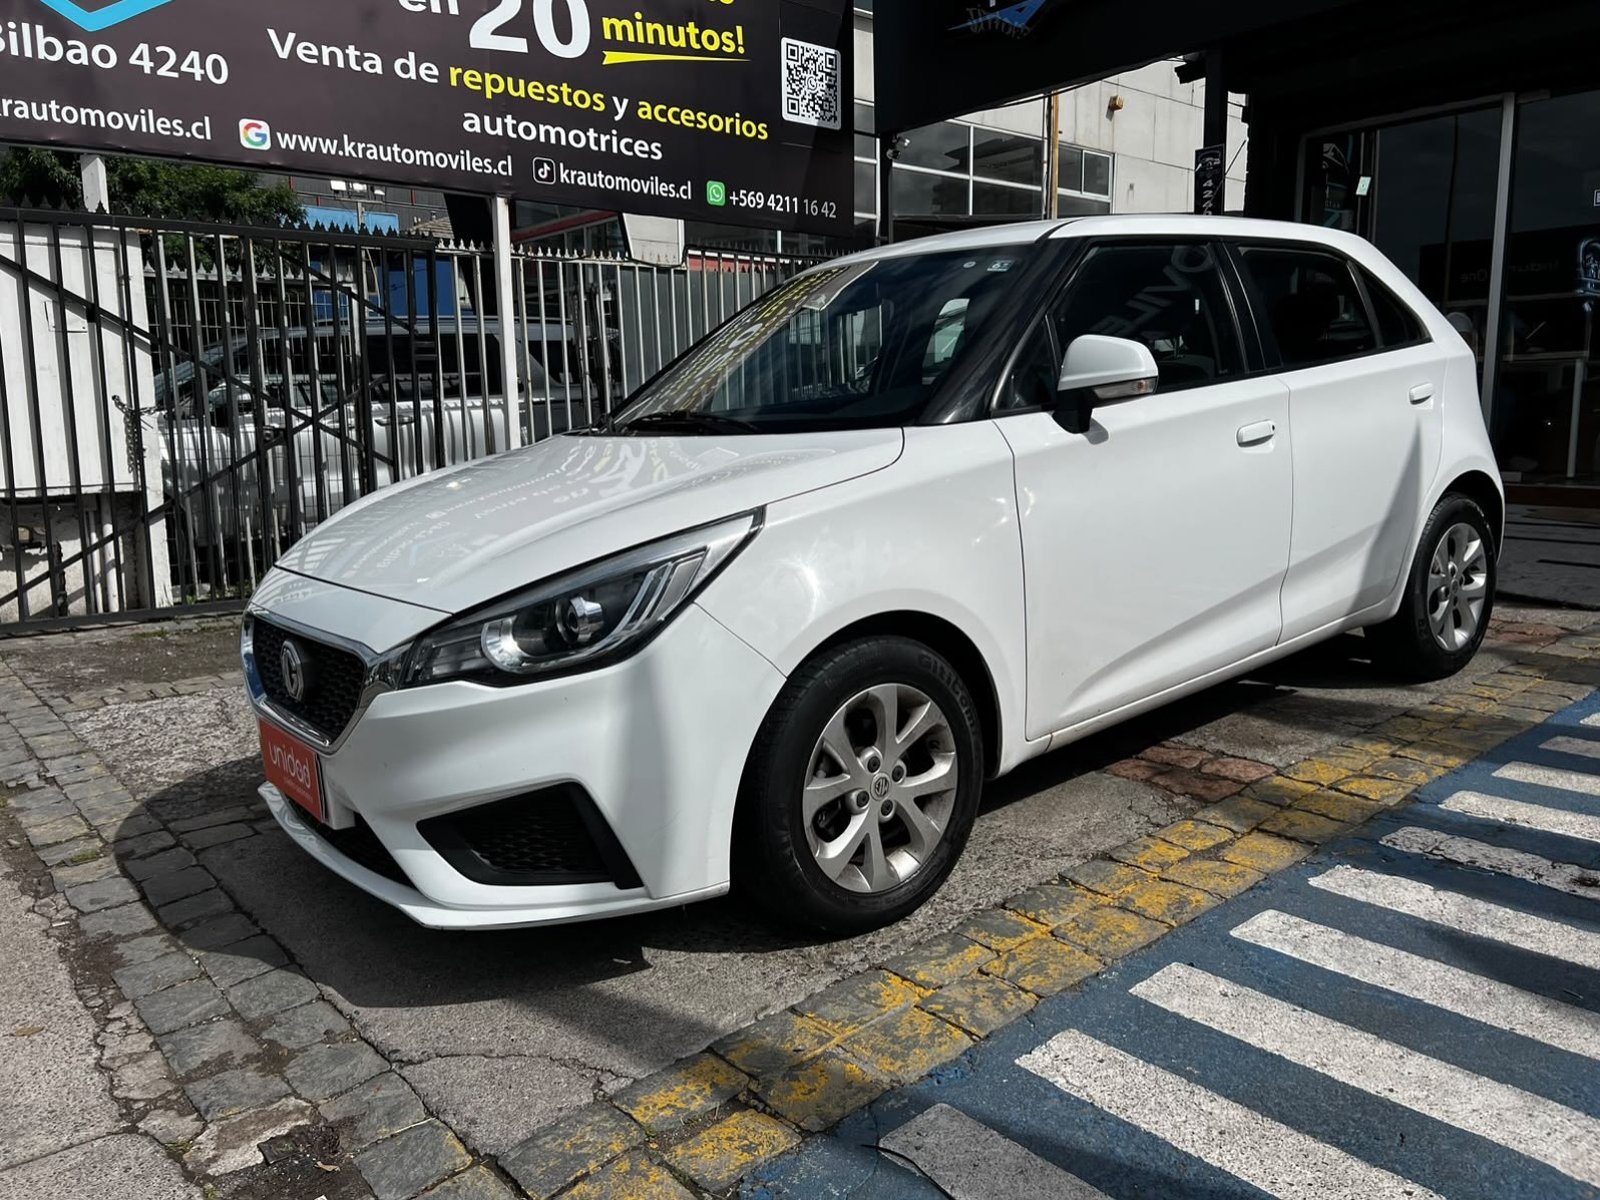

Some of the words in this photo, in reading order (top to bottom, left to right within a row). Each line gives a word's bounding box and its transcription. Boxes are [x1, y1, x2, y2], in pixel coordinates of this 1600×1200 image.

[469, 0, 591, 59] 20
[602, 12, 745, 54] minutos!
[129, 43, 229, 85] 4240
[267, 28, 383, 75] Venta
[394, 51, 439, 83] de
[449, 64, 606, 112] repuestos
[612, 96, 629, 121] y
[637, 100, 769, 140] accesorios
[0, 98, 212, 140] rautomoviles.cl
[462, 111, 663, 160] automotrices
[276, 132, 513, 176] www.krautomoviles.cl
[560, 162, 692, 199] krautomoviles.cl
[729, 189, 765, 209] +569
[767, 193, 798, 214] 4211
[803, 199, 819, 216] 16
[821, 201, 837, 218] 42
[268, 741, 311, 789] unidad
